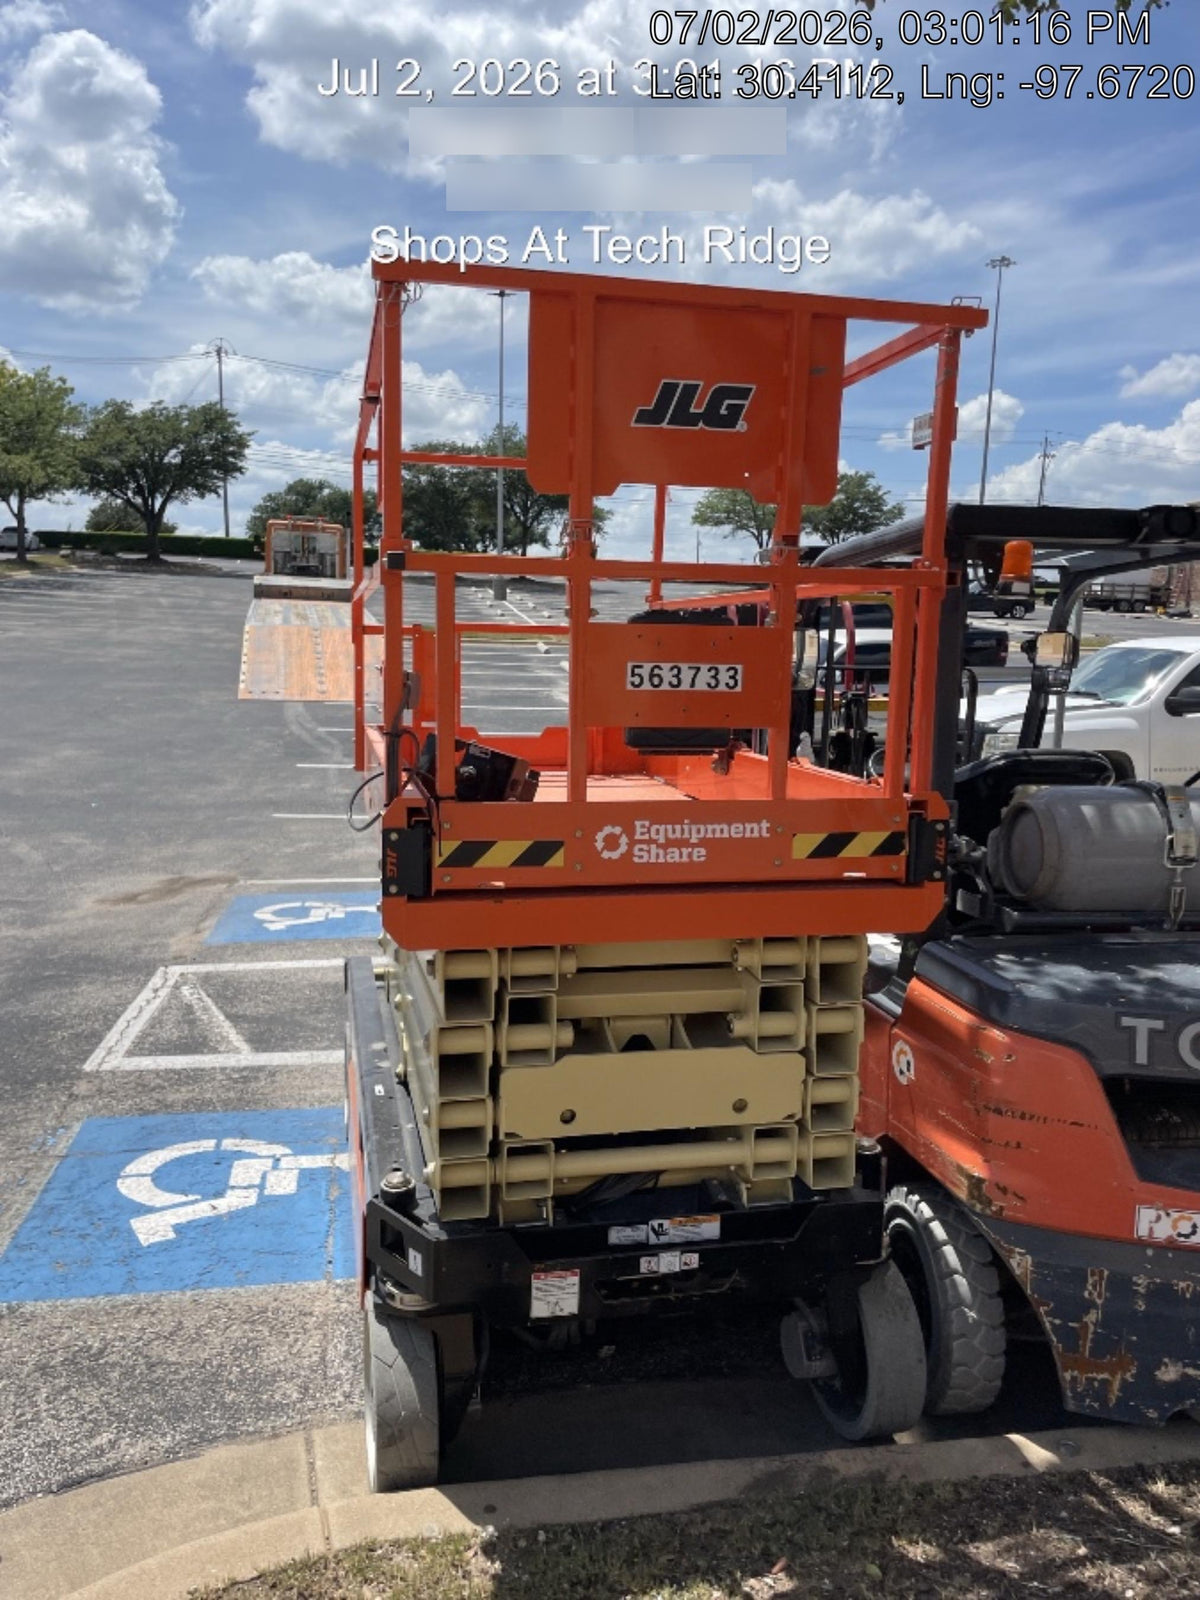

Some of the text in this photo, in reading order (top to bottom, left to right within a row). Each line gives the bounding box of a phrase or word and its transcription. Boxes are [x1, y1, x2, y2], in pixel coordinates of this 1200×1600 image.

[631, 379, 756, 432] JLG
[629, 664, 739, 690] 563733
[633, 819, 771, 843] Equipment
[632, 844, 707, 863] Share
